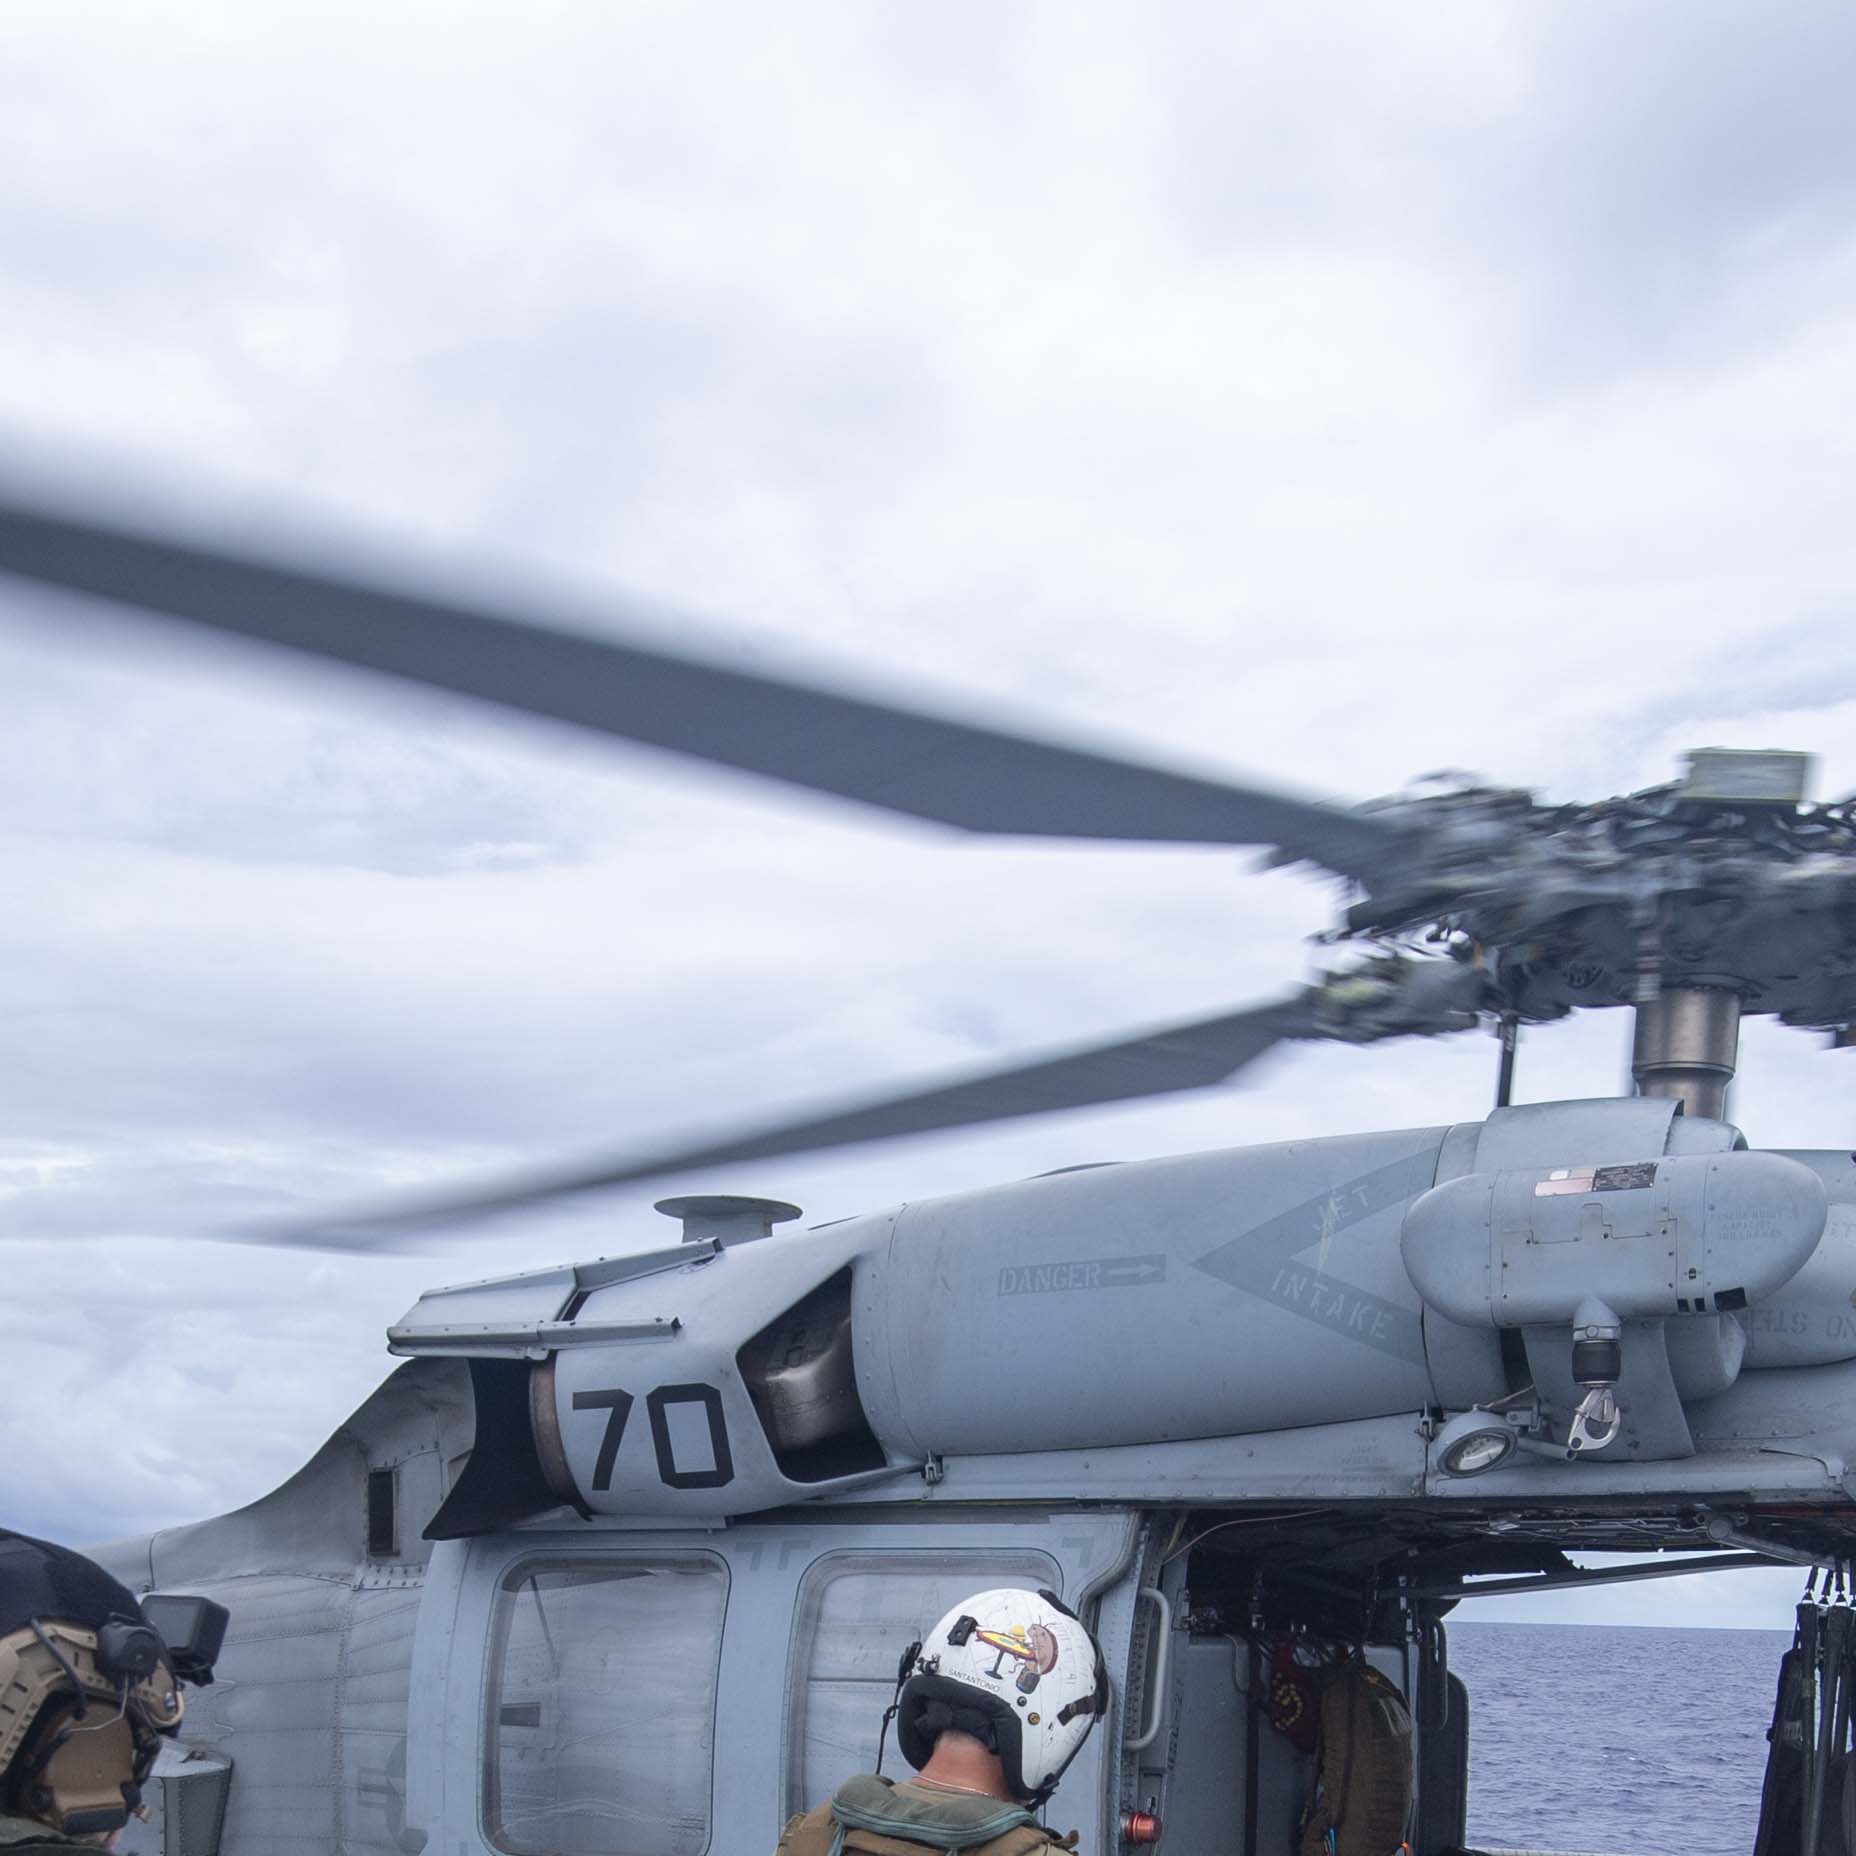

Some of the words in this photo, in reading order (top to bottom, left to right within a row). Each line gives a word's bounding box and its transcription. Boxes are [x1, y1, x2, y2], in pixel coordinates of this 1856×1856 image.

[1312, 1185, 1369, 1232] JET
[1000, 1263, 1102, 1295] DANGER
[1271, 1268, 1394, 1339] INTAKE
[572, 1382, 735, 1491] 70
[948, 1667, 1001, 1693] SANTANTONIO
